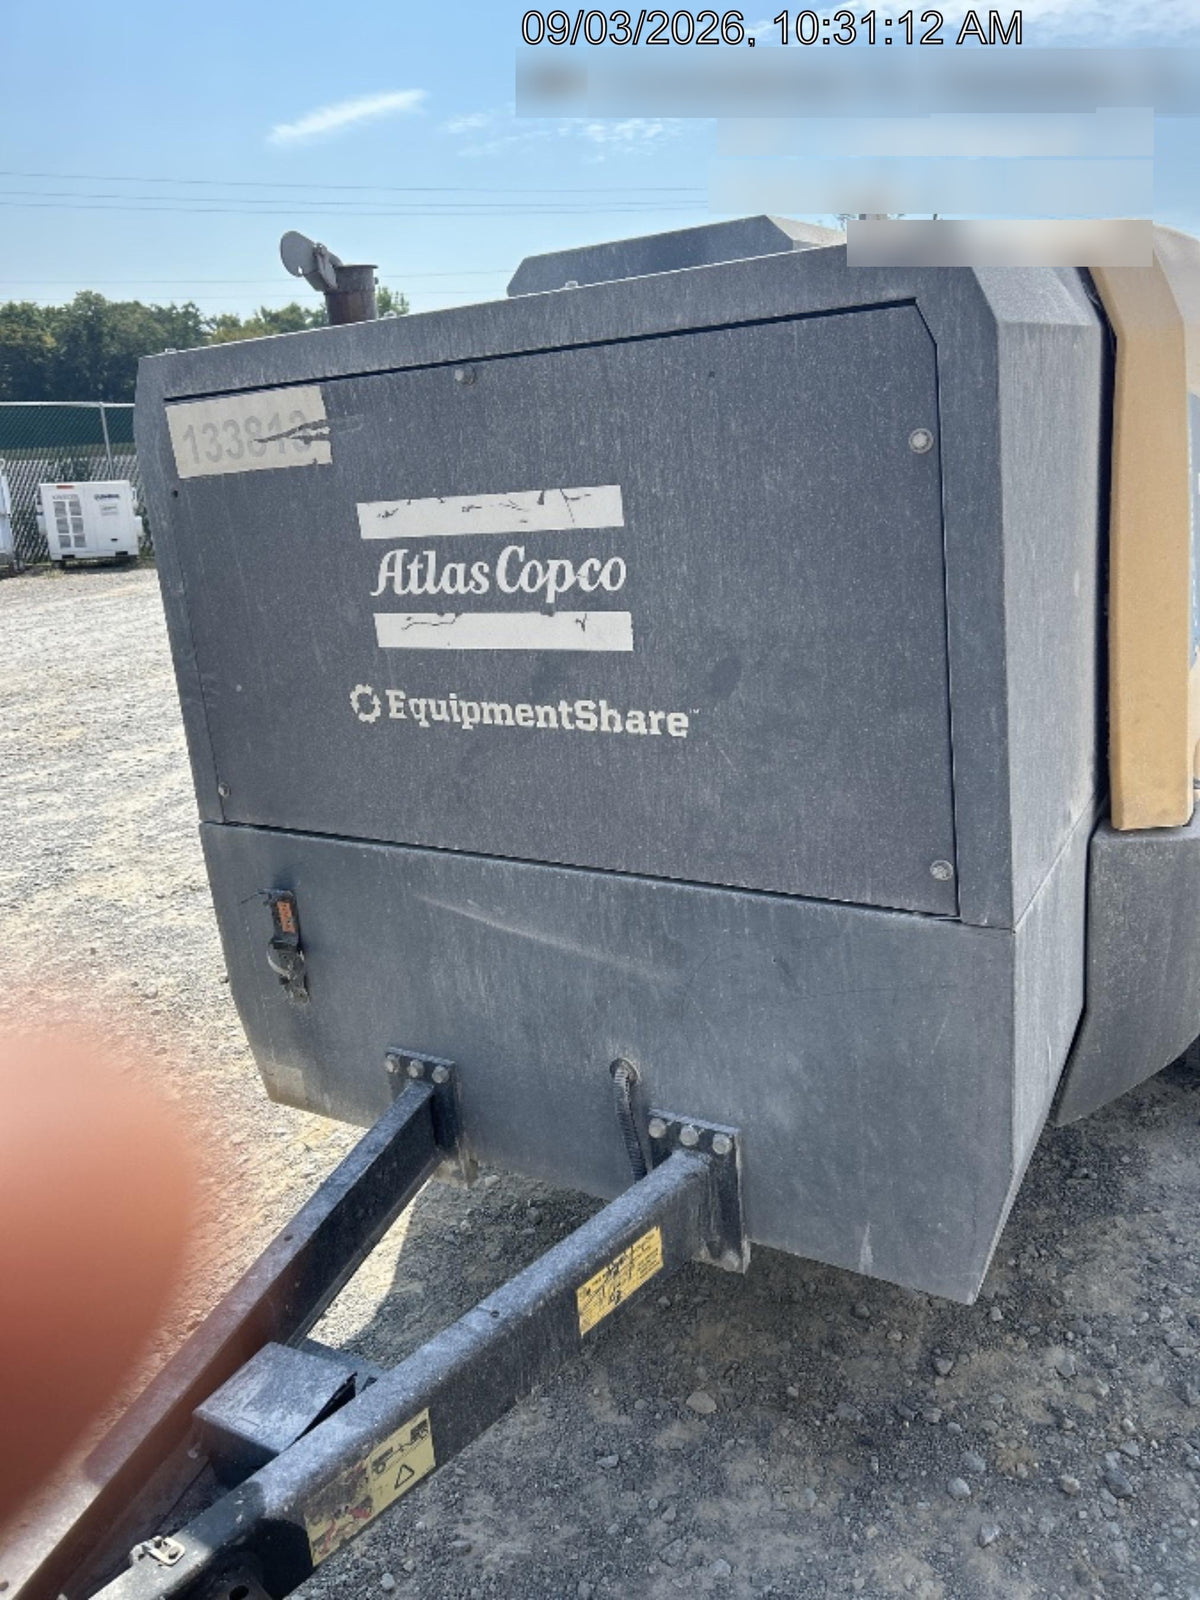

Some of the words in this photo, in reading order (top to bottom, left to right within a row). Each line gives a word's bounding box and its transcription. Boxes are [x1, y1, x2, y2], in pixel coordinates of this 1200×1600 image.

[370, 547, 490, 597] Atlas
[496, 545, 627, 603] Copco
[385, 689, 690, 739] EquipmentShare
